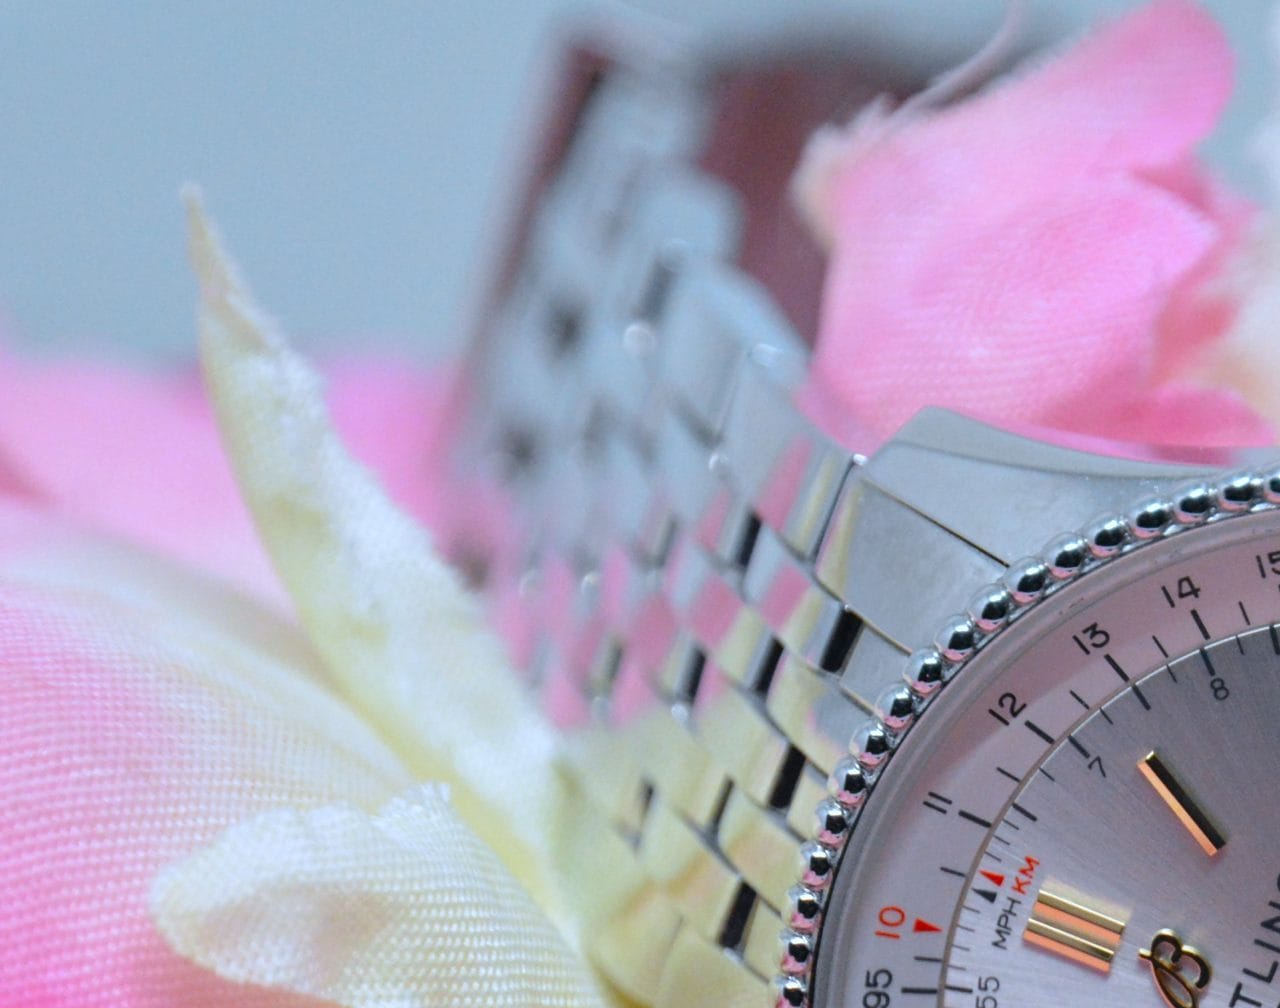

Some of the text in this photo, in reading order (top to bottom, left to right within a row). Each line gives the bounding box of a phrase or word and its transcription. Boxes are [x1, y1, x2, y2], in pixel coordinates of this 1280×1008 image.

[1161, 576, 1200, 608] 14
[1072, 622, 1110, 655] 13
[1210, 678, 1229, 700] 8
[988, 692, 1027, 726] 12
[1087, 756, 1106, 778] 7
[923, 792, 952, 814] 11
[992, 855, 1041, 950] MPH KM
[875, 906, 906, 939] 10
